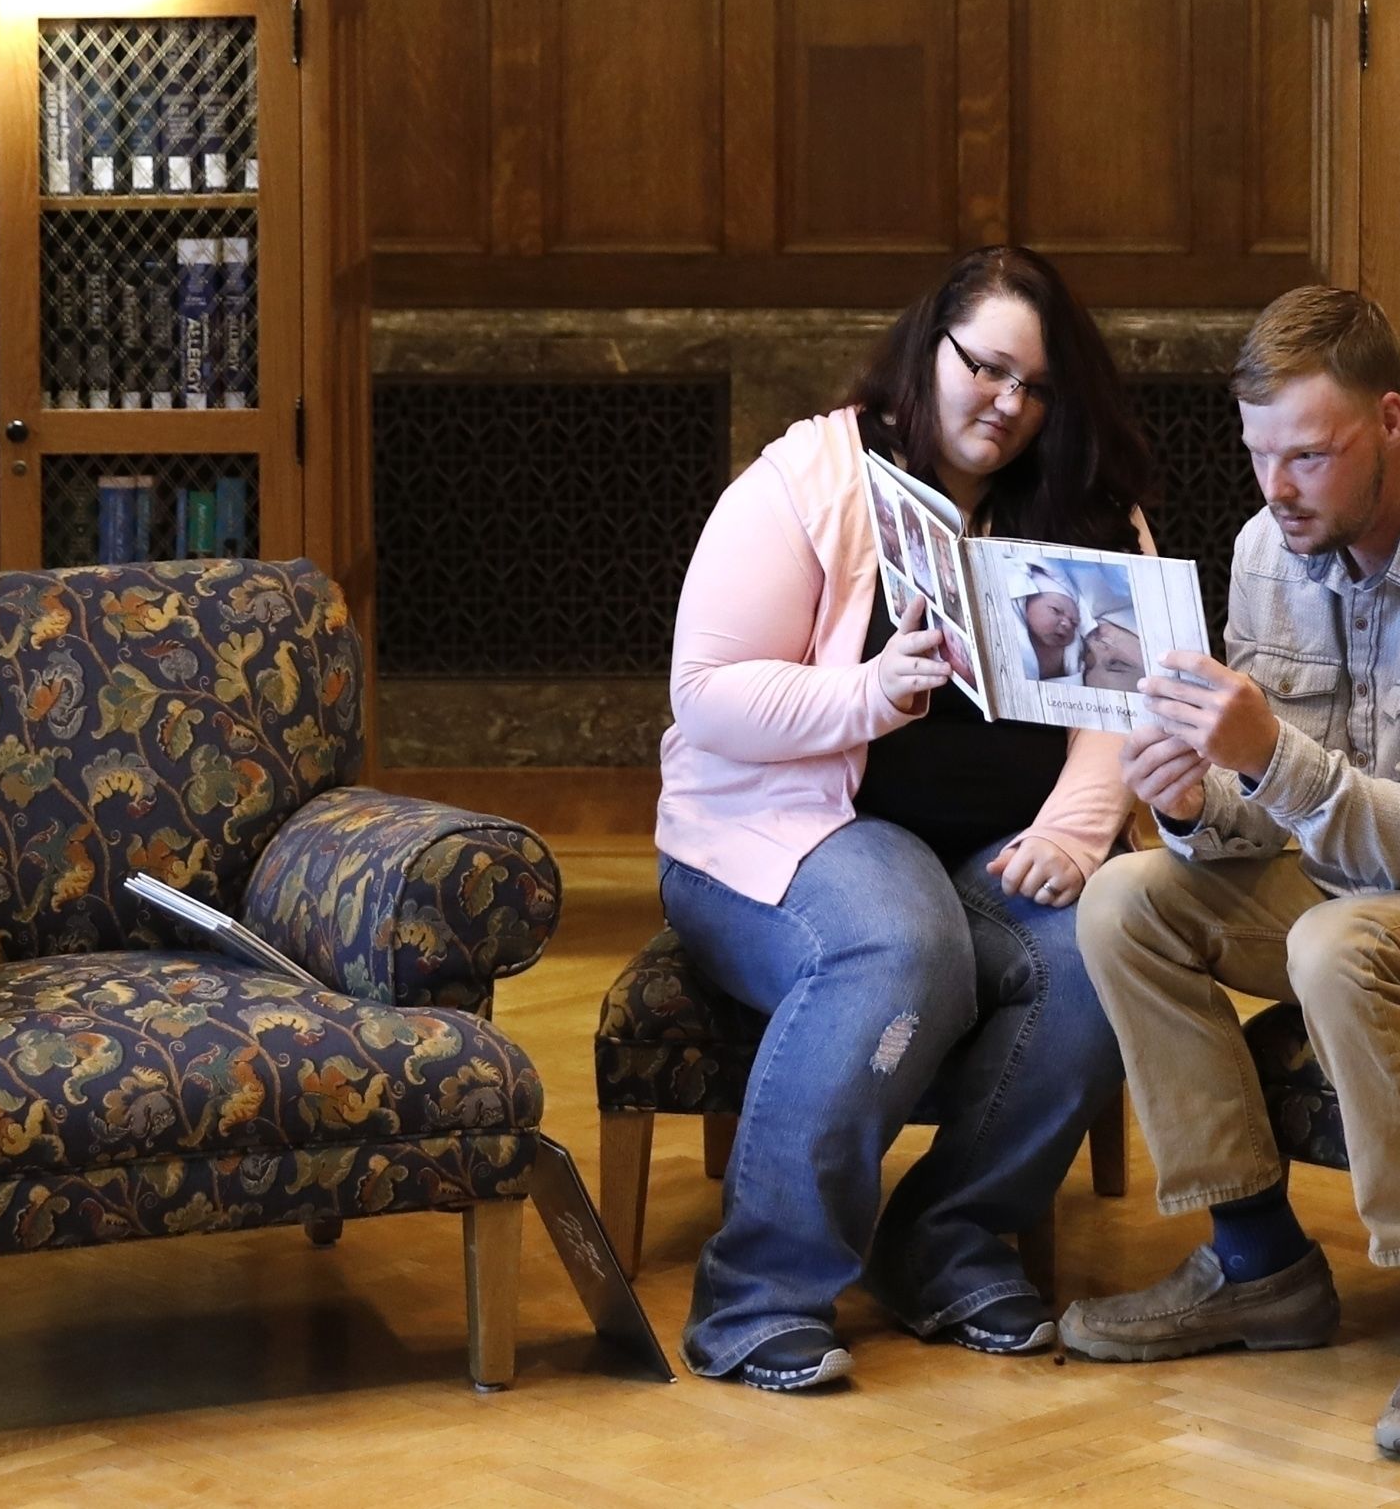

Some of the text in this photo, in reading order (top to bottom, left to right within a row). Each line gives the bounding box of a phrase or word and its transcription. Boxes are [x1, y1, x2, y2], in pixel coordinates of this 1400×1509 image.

[186, 317, 201, 394] ALLERGY
[227, 313, 241, 371] ALLERGY
[1046, 696, 1084, 711] Leonard
[1085, 702, 1114, 713] Daniel
